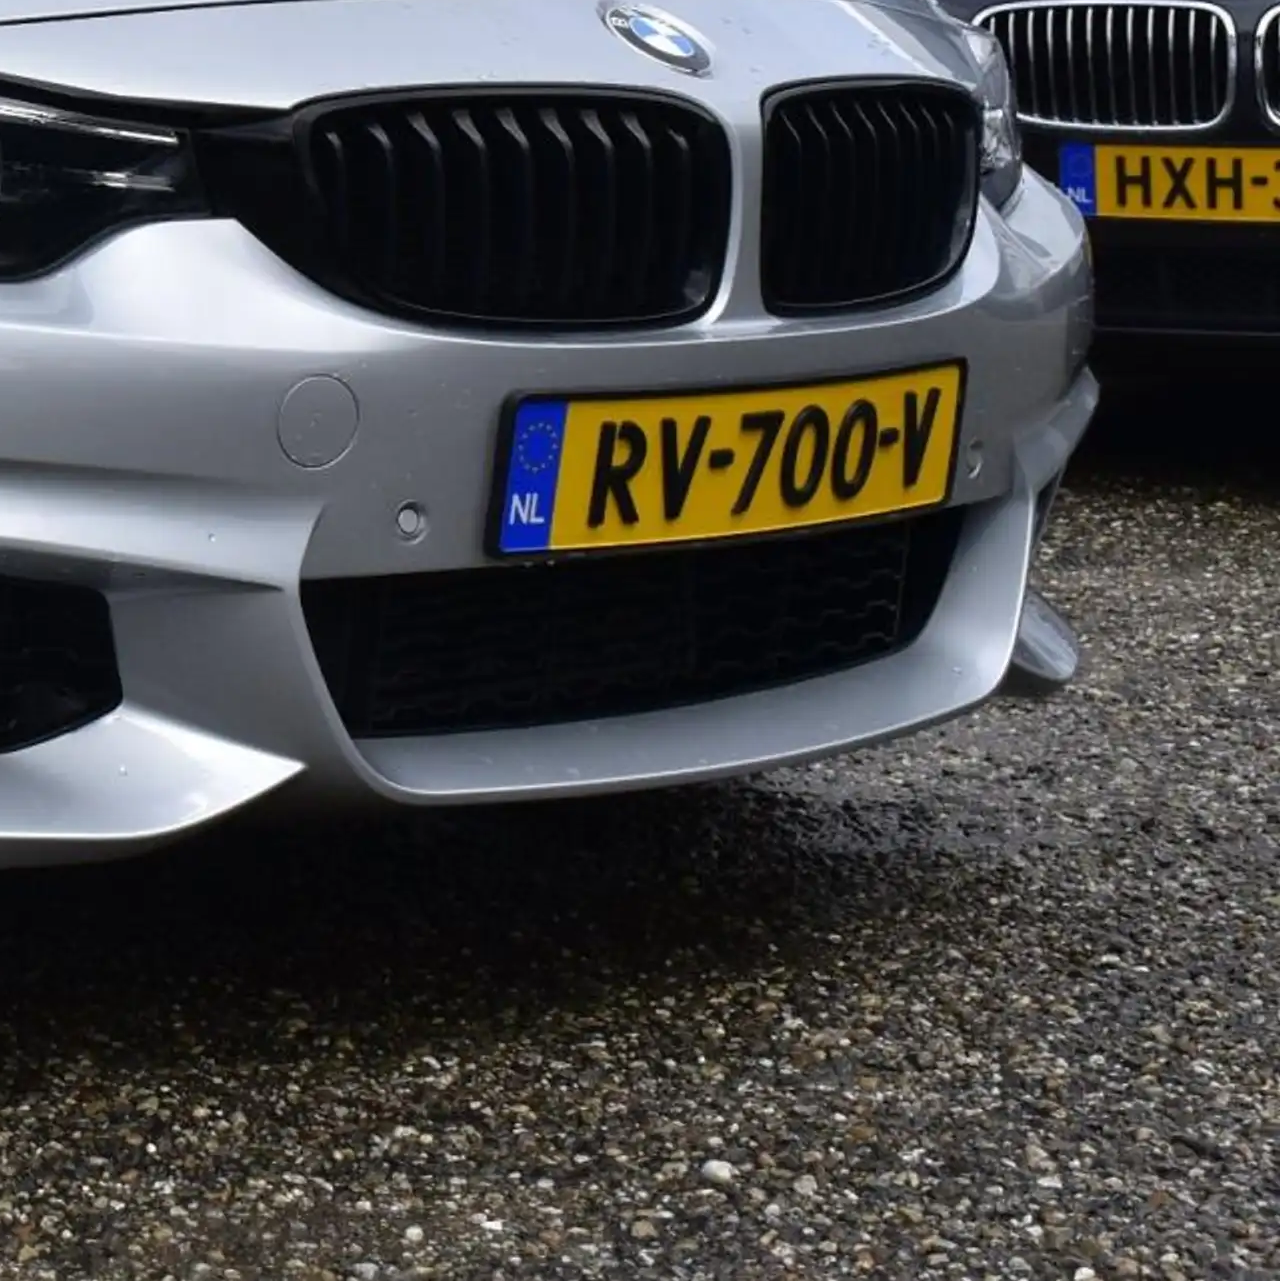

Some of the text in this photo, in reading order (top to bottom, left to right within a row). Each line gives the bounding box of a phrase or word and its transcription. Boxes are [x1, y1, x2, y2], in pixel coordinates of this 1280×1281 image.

[1115, 155, 1280, 211] HXH-
[587, 388, 941, 529] RV-700-V
[509, 493, 545, 525] NL
